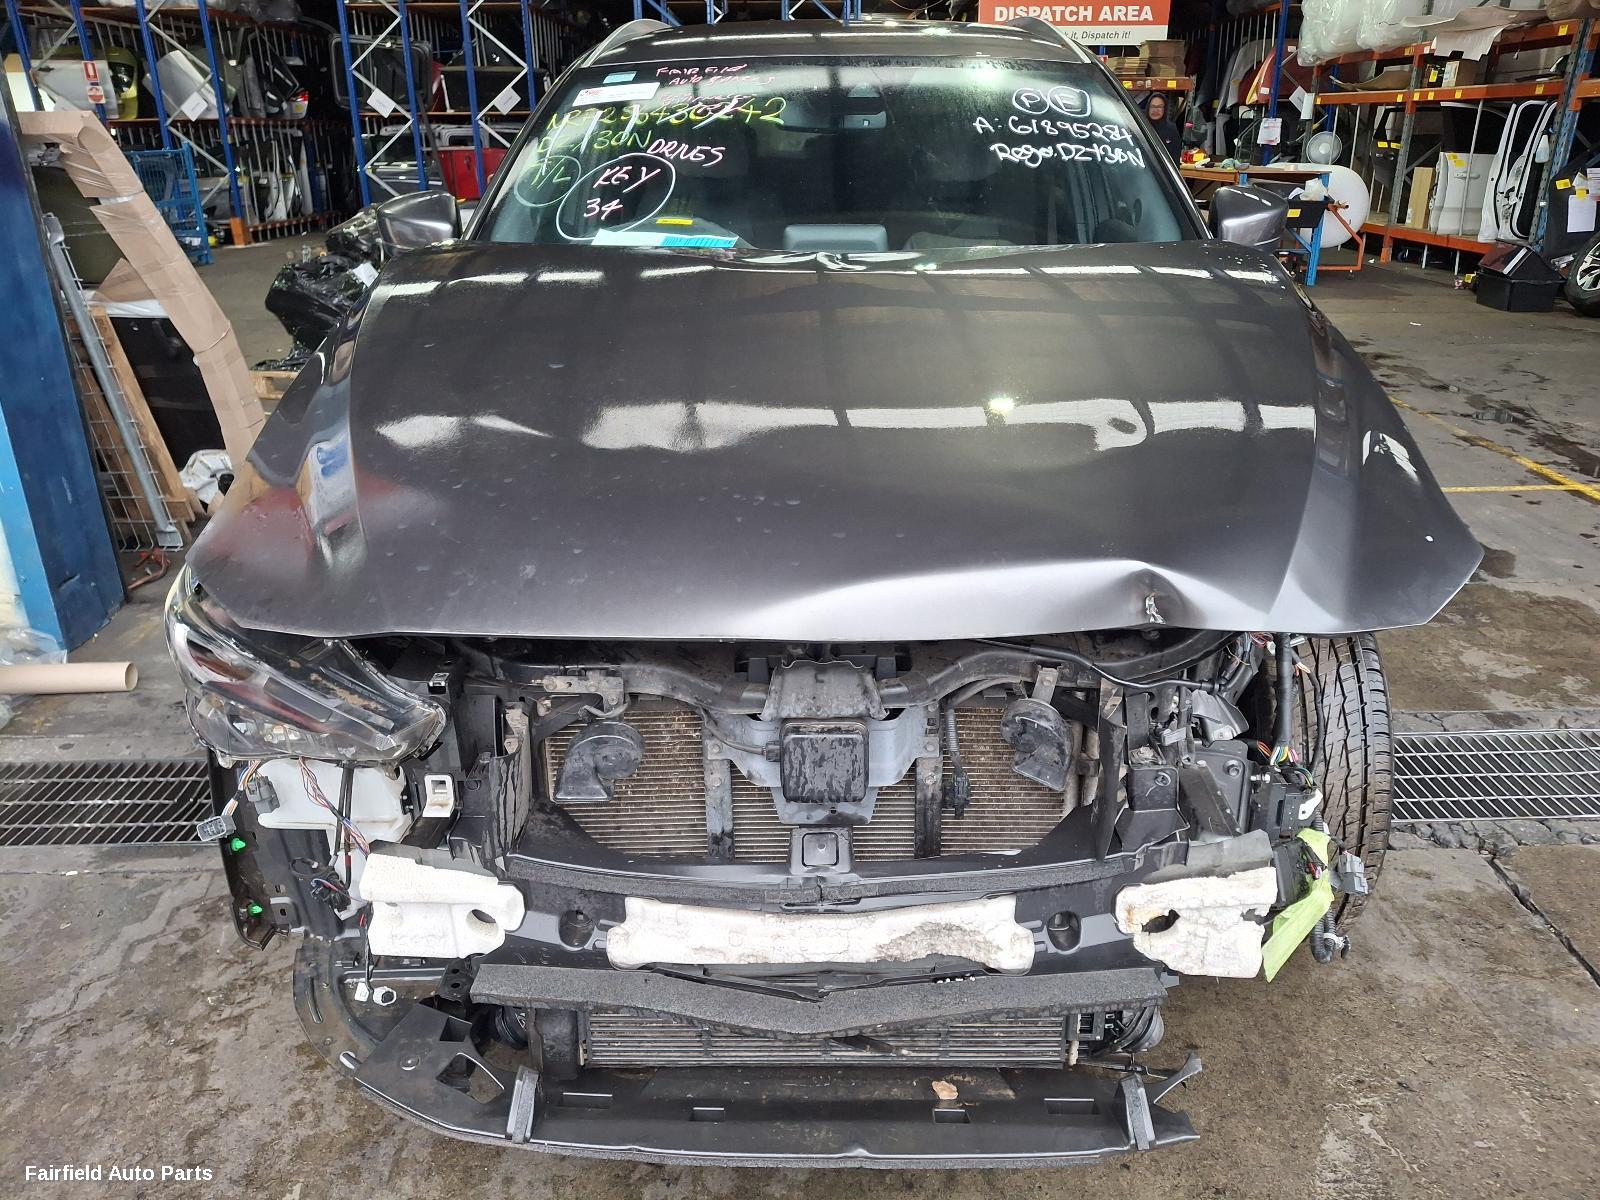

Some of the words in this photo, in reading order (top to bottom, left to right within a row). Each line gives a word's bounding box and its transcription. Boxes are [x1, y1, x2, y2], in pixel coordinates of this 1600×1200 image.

[994, 5, 1092, 21] DISPATCH
[1098, 5, 1154, 21] AREA
[1081, 31, 1120, 40] Dispatch
[646, 138, 726, 167] DRIVES
[593, 165, 661, 194] KEY
[583, 198, 624, 221] 34
